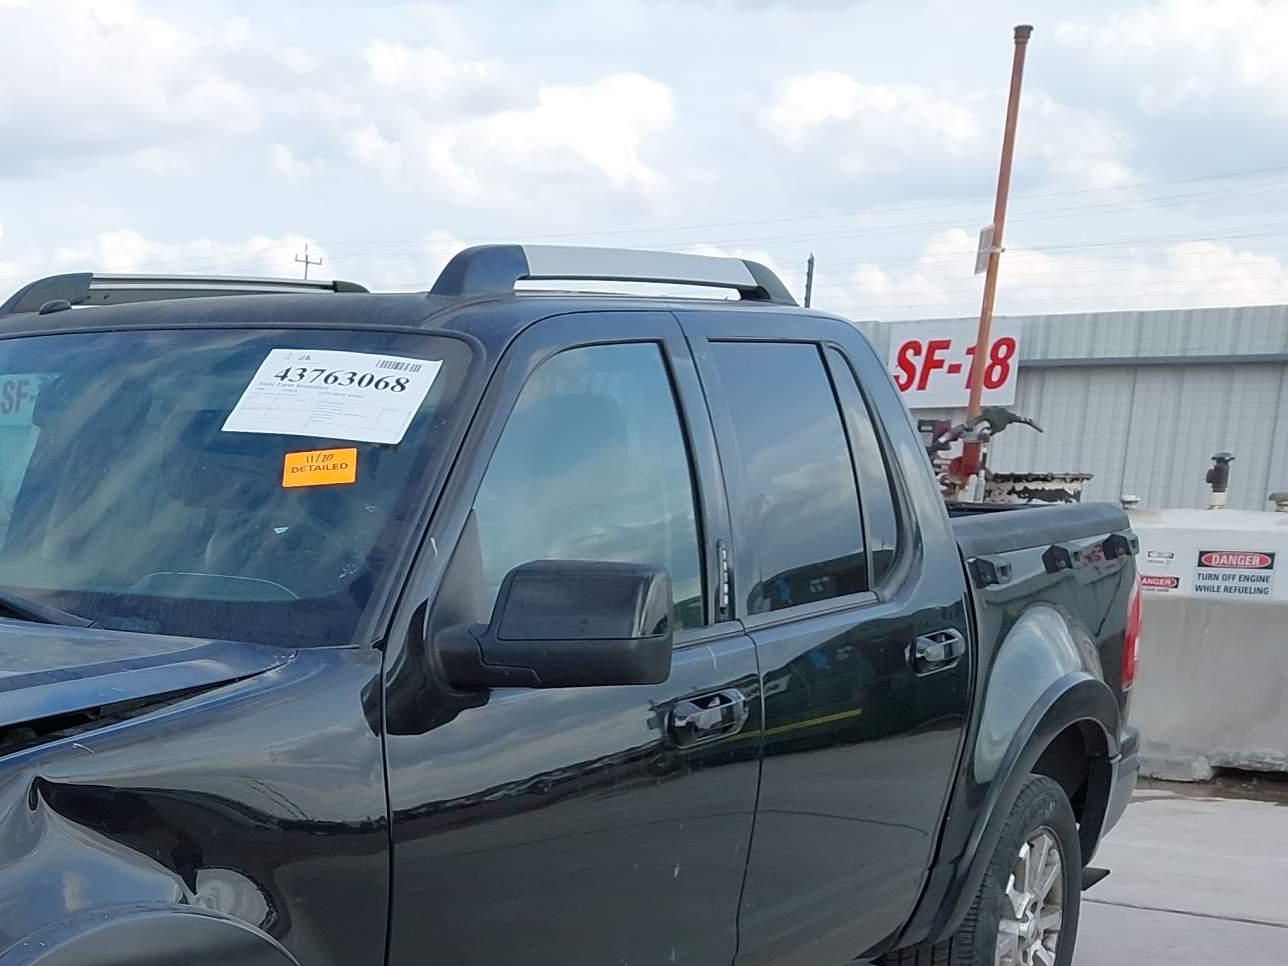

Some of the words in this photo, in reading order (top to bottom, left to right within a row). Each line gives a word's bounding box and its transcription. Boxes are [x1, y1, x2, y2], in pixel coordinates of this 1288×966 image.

[894, 337, 1016, 392] SF-18
[274, 366, 410, 393] 43763068
[1, 379, 37, 415] SF-
[291, 462, 348, 473] DETAILED
[1211, 554, 1261, 566] DANGER
[1142, 577, 1172, 586] ANGER
[1197, 573, 1220, 581] TURN
[1222, 573, 1237, 582] OFF
[1238, 574, 1271, 583] ENGINE
[1195, 584, 1221, 593] WHILE
[1223, 585, 1270, 595] REFUELING
